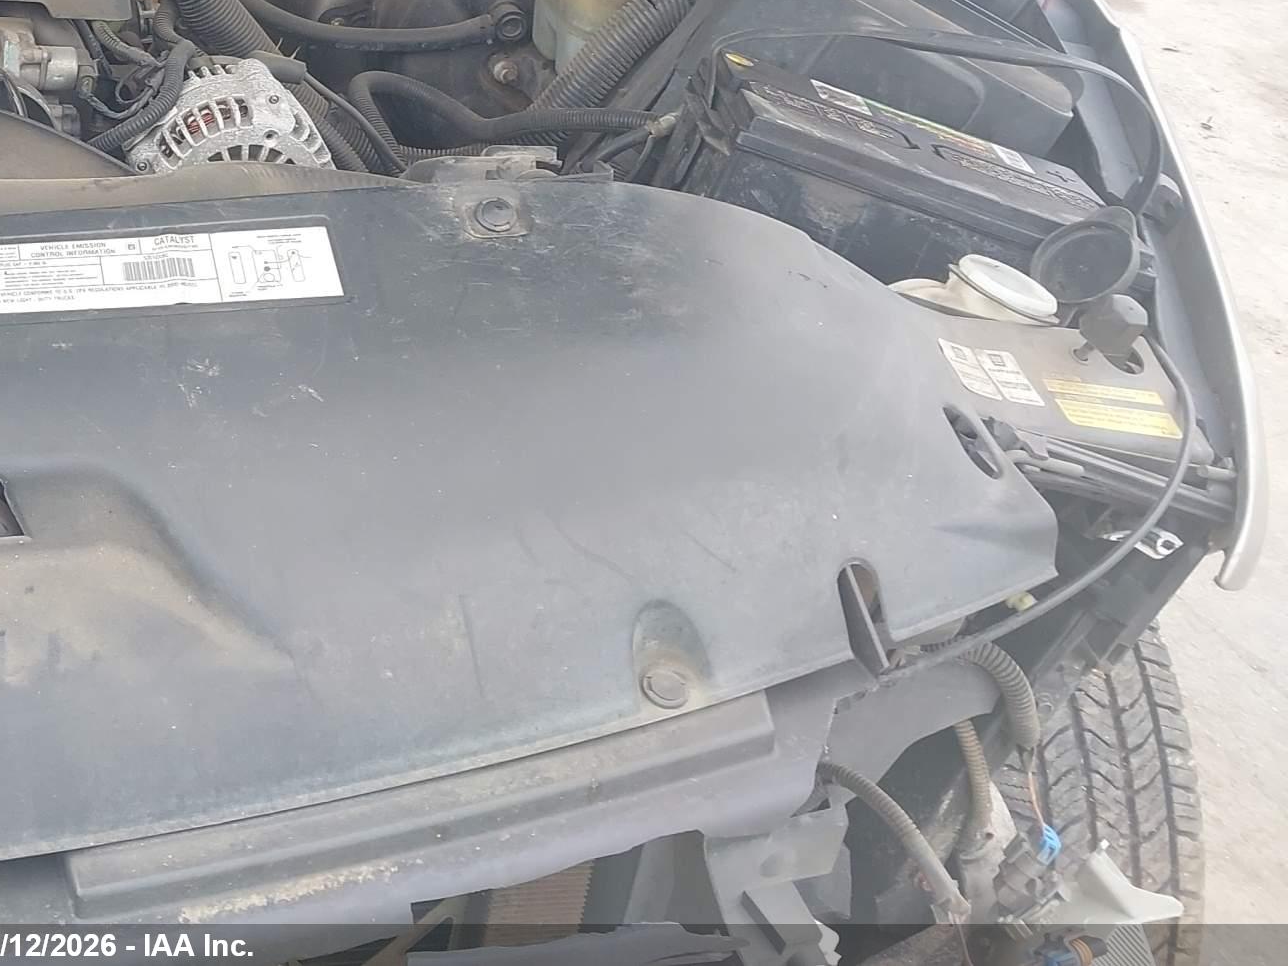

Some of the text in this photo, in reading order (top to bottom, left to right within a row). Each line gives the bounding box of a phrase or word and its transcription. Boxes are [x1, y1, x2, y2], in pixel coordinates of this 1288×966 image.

[72, 242, 107, 250] EMISSION
[153, 235, 195, 246] CATALYST
[30, 248, 116, 259] CONTROL INFORMATION
